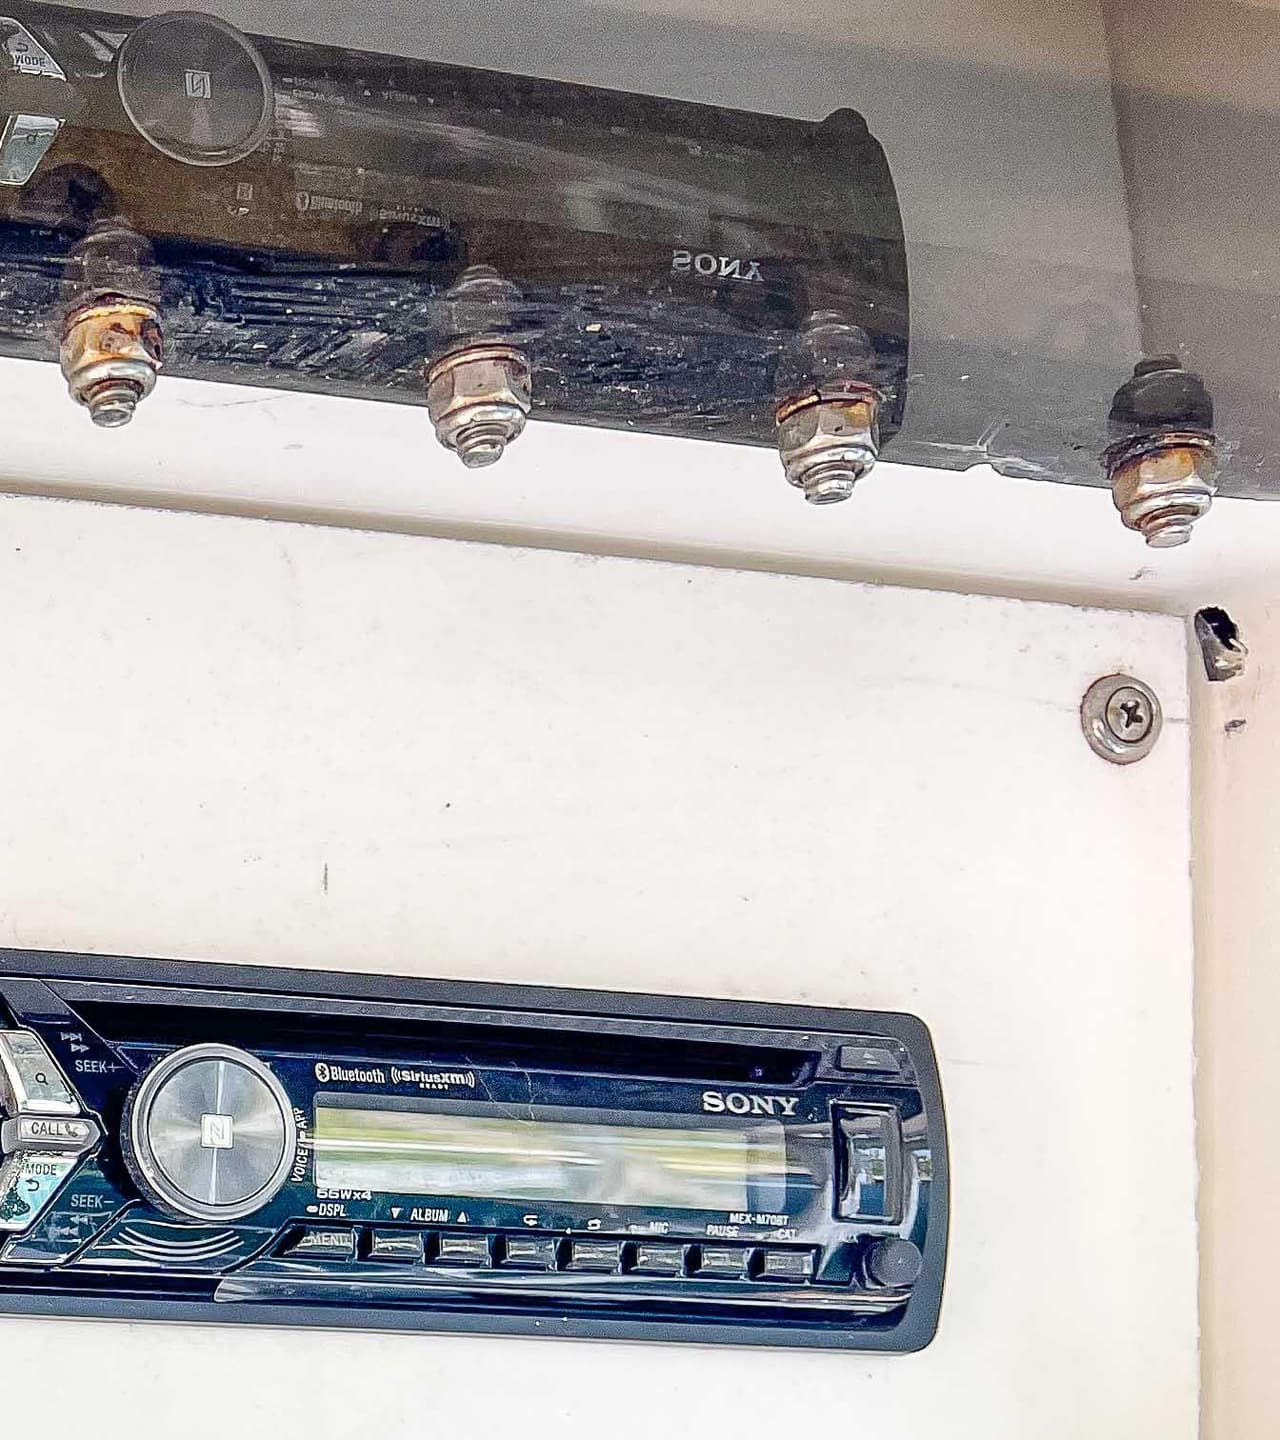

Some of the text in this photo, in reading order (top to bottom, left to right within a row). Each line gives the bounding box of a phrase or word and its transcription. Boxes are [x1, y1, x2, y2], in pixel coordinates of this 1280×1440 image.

[330, 1066, 386, 1084] Bluetooth
[702, 1091, 800, 1117] SONY
[31, 1122, 63, 1136] CALL
[23, 1164, 57, 1176] MODE
[319, 1203, 347, 1217] DSPL
[410, 1208, 449, 1222] ALBUM
[706, 1224, 740, 1238] PAUSE
